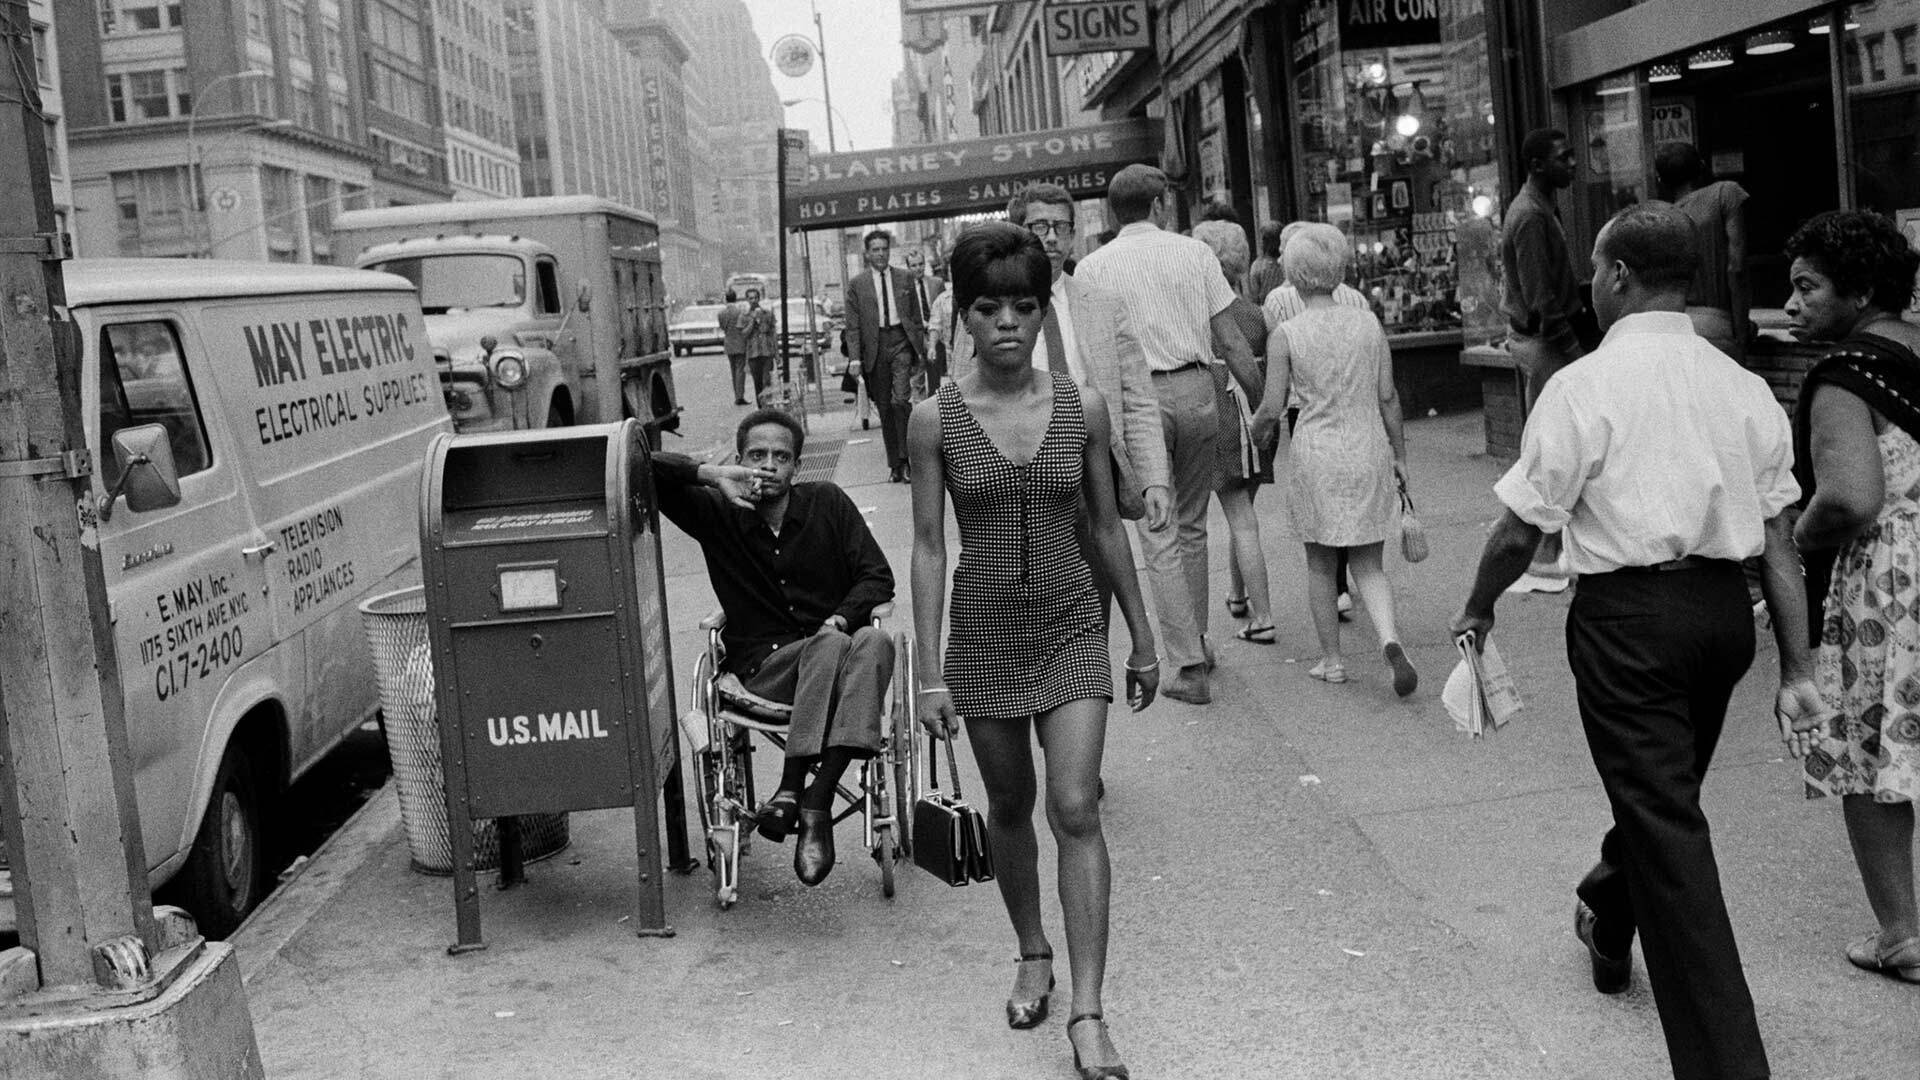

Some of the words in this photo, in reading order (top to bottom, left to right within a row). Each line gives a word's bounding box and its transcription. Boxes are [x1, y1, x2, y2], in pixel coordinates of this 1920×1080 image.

[1054, 4, 1140, 40] SIGNS
[1350, 0, 1387, 24] AIR
[992, 131, 1113, 162] STONE
[800, 201, 839, 219] HOT
[857, 189, 942, 212] PLATES
[243, 321, 306, 387] MAY
[308, 313, 414, 376] ELECTRIC
[255, 390, 357, 445] ELECTRICAL
[363, 373, 427, 416] SUPPLIES
[280, 505, 343, 552] TELEVISION
[287, 547, 322, 583] RADIO
[294, 561, 355, 616] APPLIANCES
[140, 634, 163, 666] 1175
[166, 617, 203, 652] SIXTH
